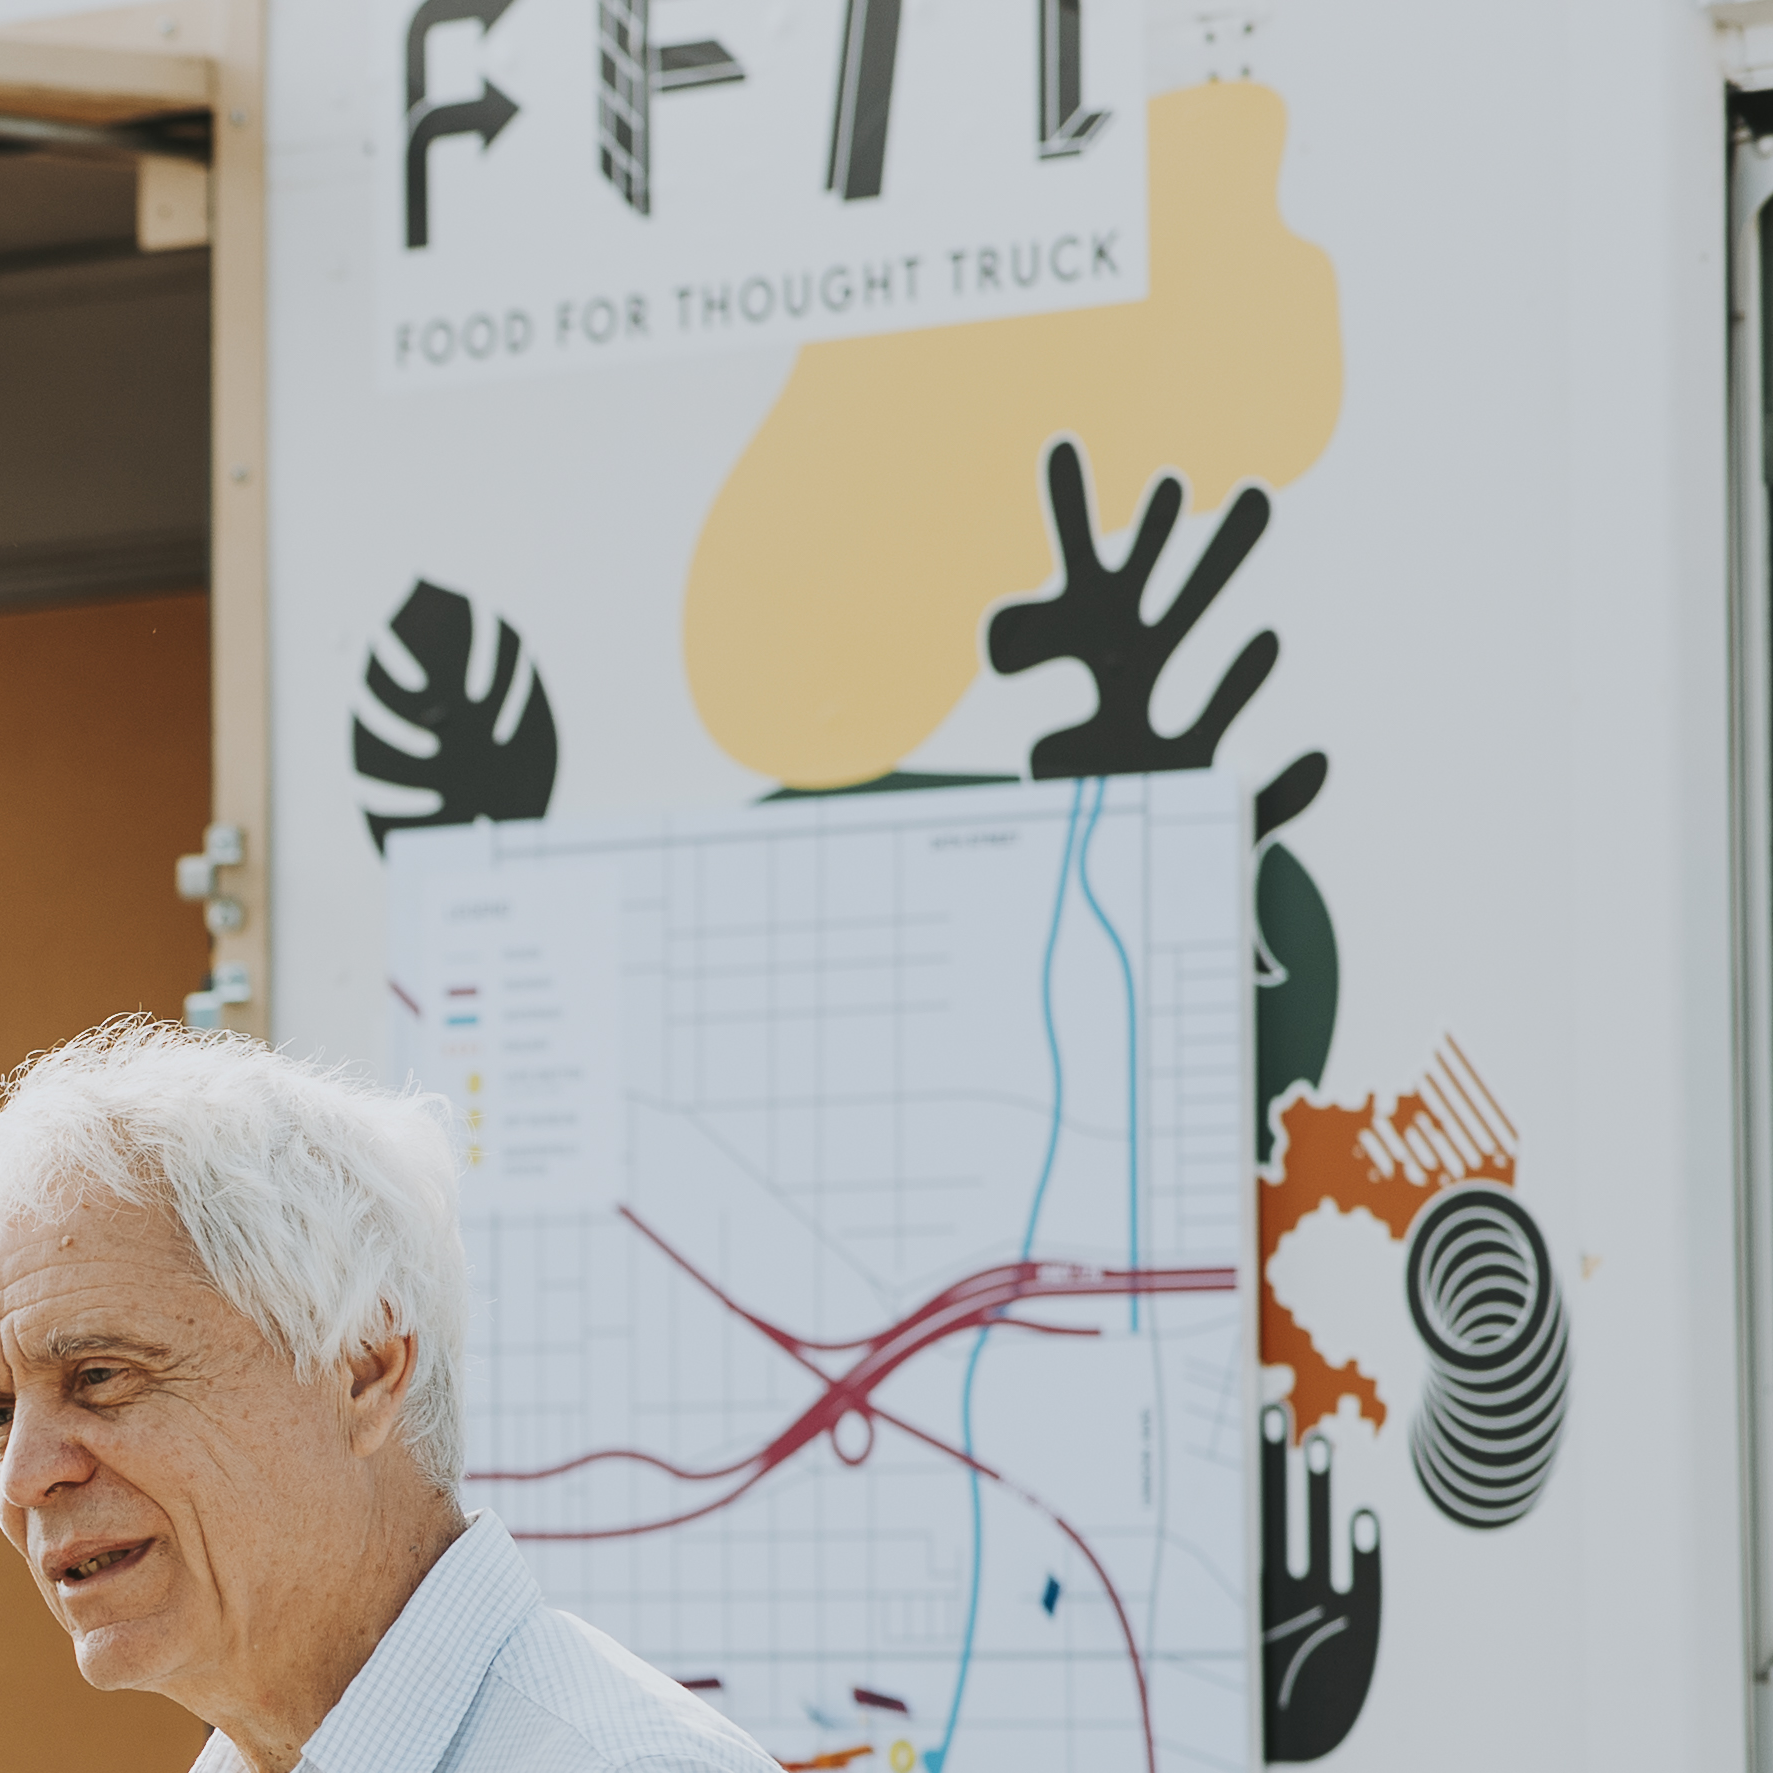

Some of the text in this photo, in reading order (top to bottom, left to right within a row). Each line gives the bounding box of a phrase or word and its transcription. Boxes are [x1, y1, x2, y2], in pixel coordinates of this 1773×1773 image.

[396, 228, 1123, 368] FOOD FOR THOUGHT TRUCK
